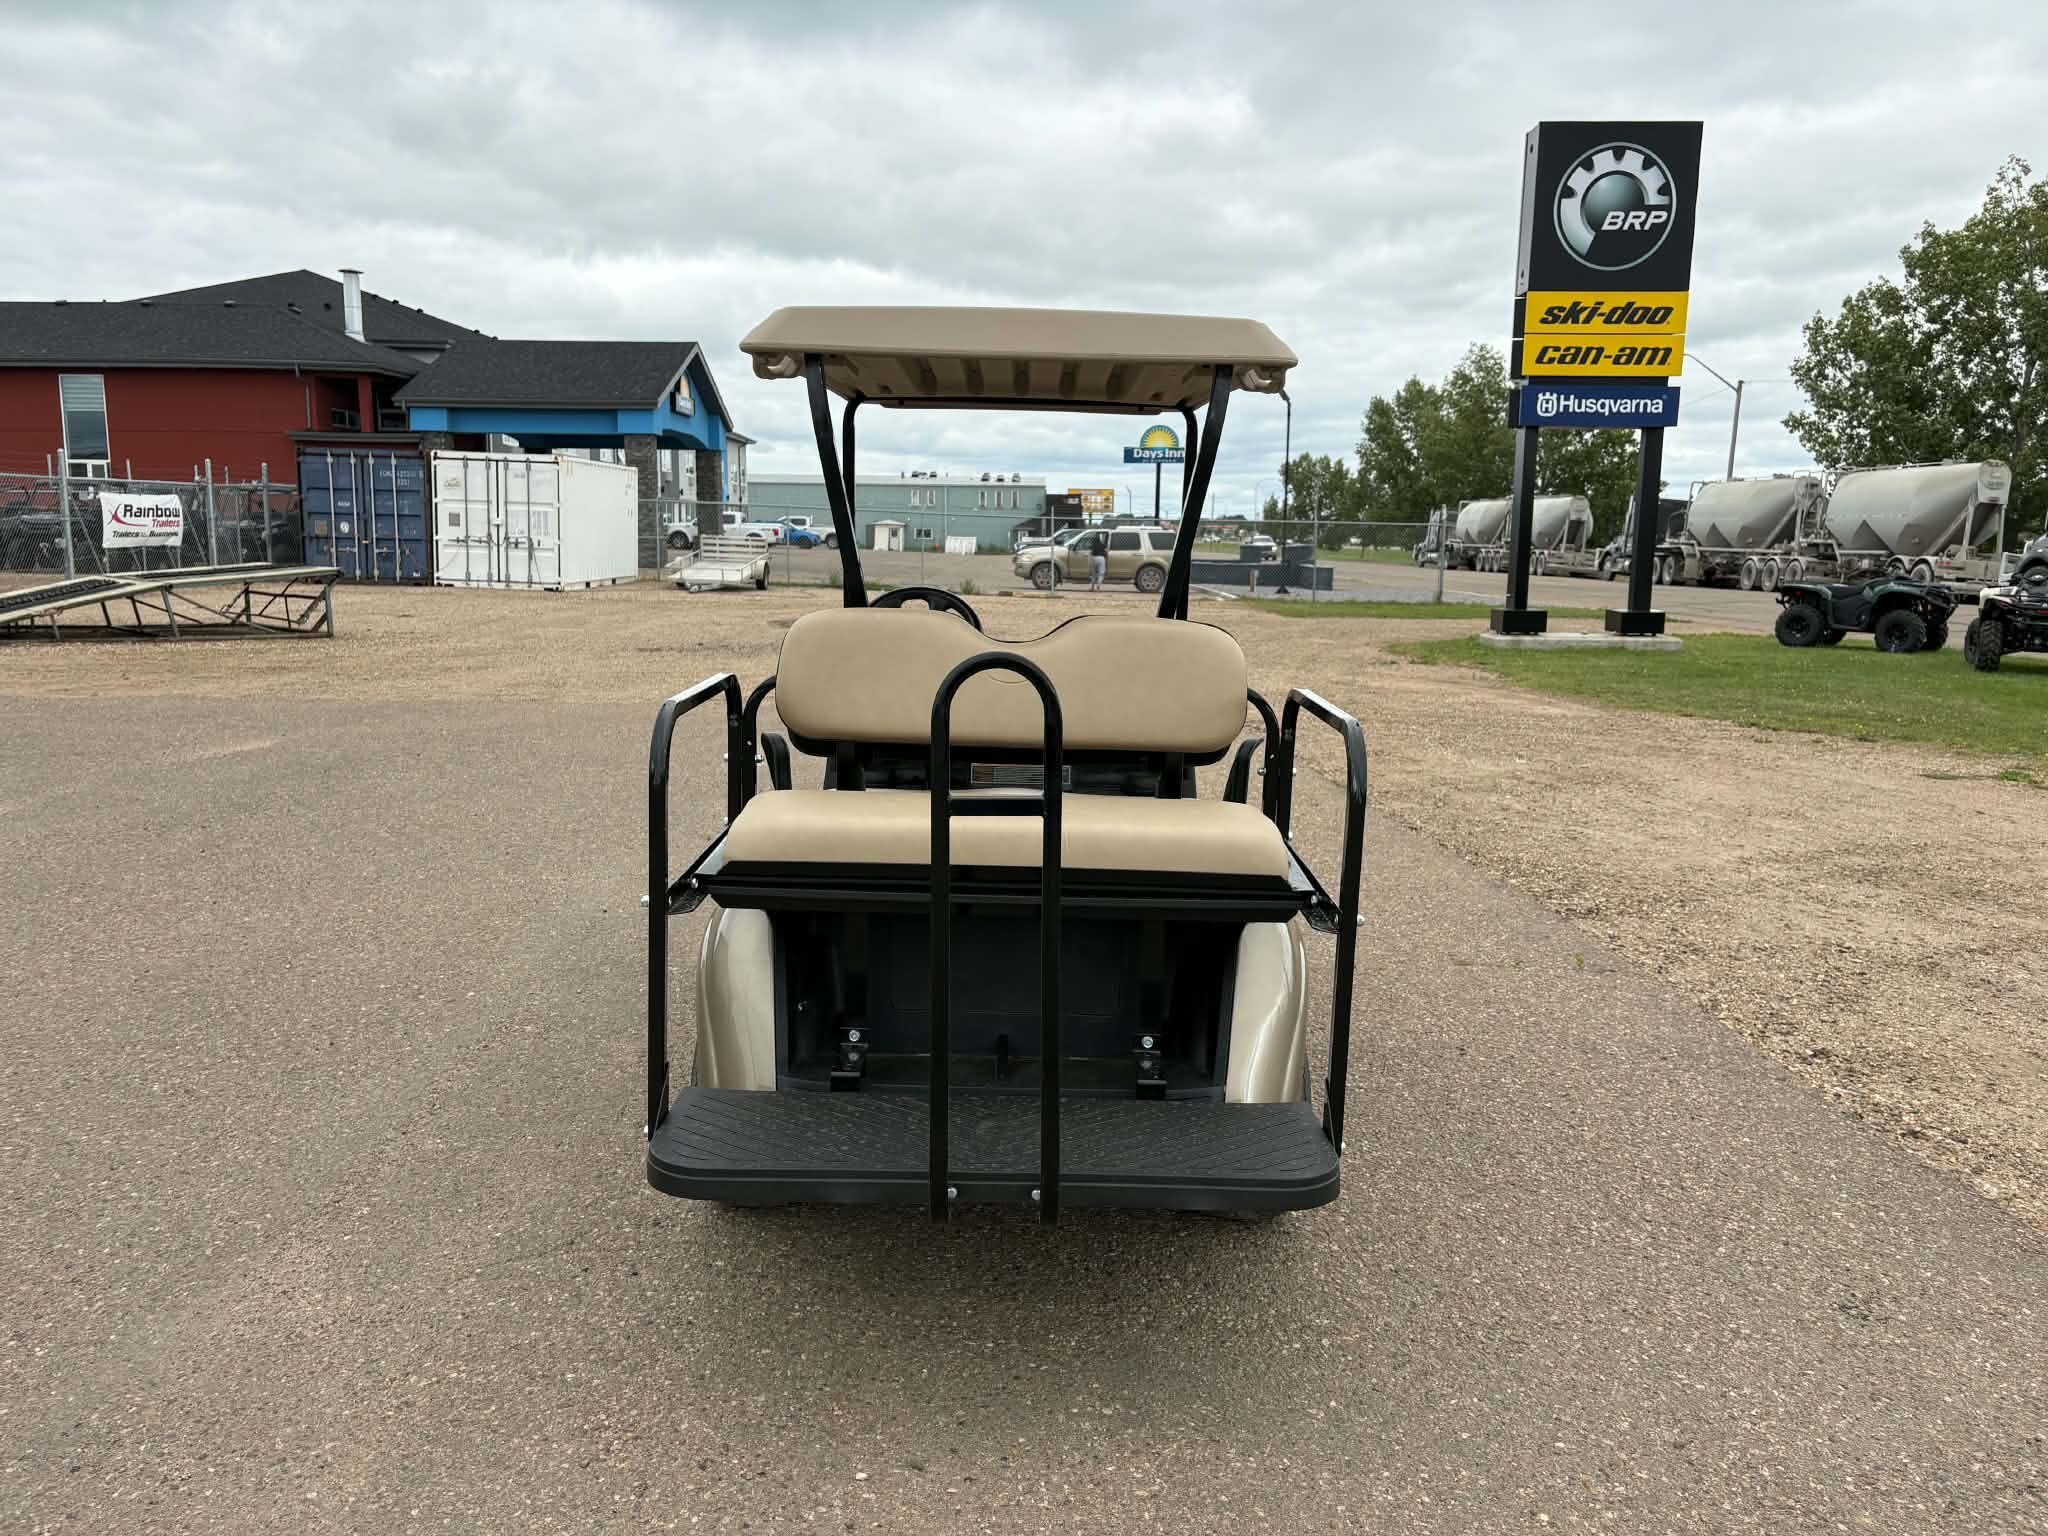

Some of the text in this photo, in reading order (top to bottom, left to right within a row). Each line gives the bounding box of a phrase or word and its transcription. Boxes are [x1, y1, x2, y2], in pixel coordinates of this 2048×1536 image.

[1601, 210, 1669, 231] BRP
[1540, 301, 1674, 325] ski-doo
[1535, 345, 1672, 366] can-am
[1559, 394, 1663, 416] Husqvarna
[1134, 448, 1184, 459] Days Inn
[123, 504, 180, 518] Rainbow
[152, 519, 180, 528] Trailers
